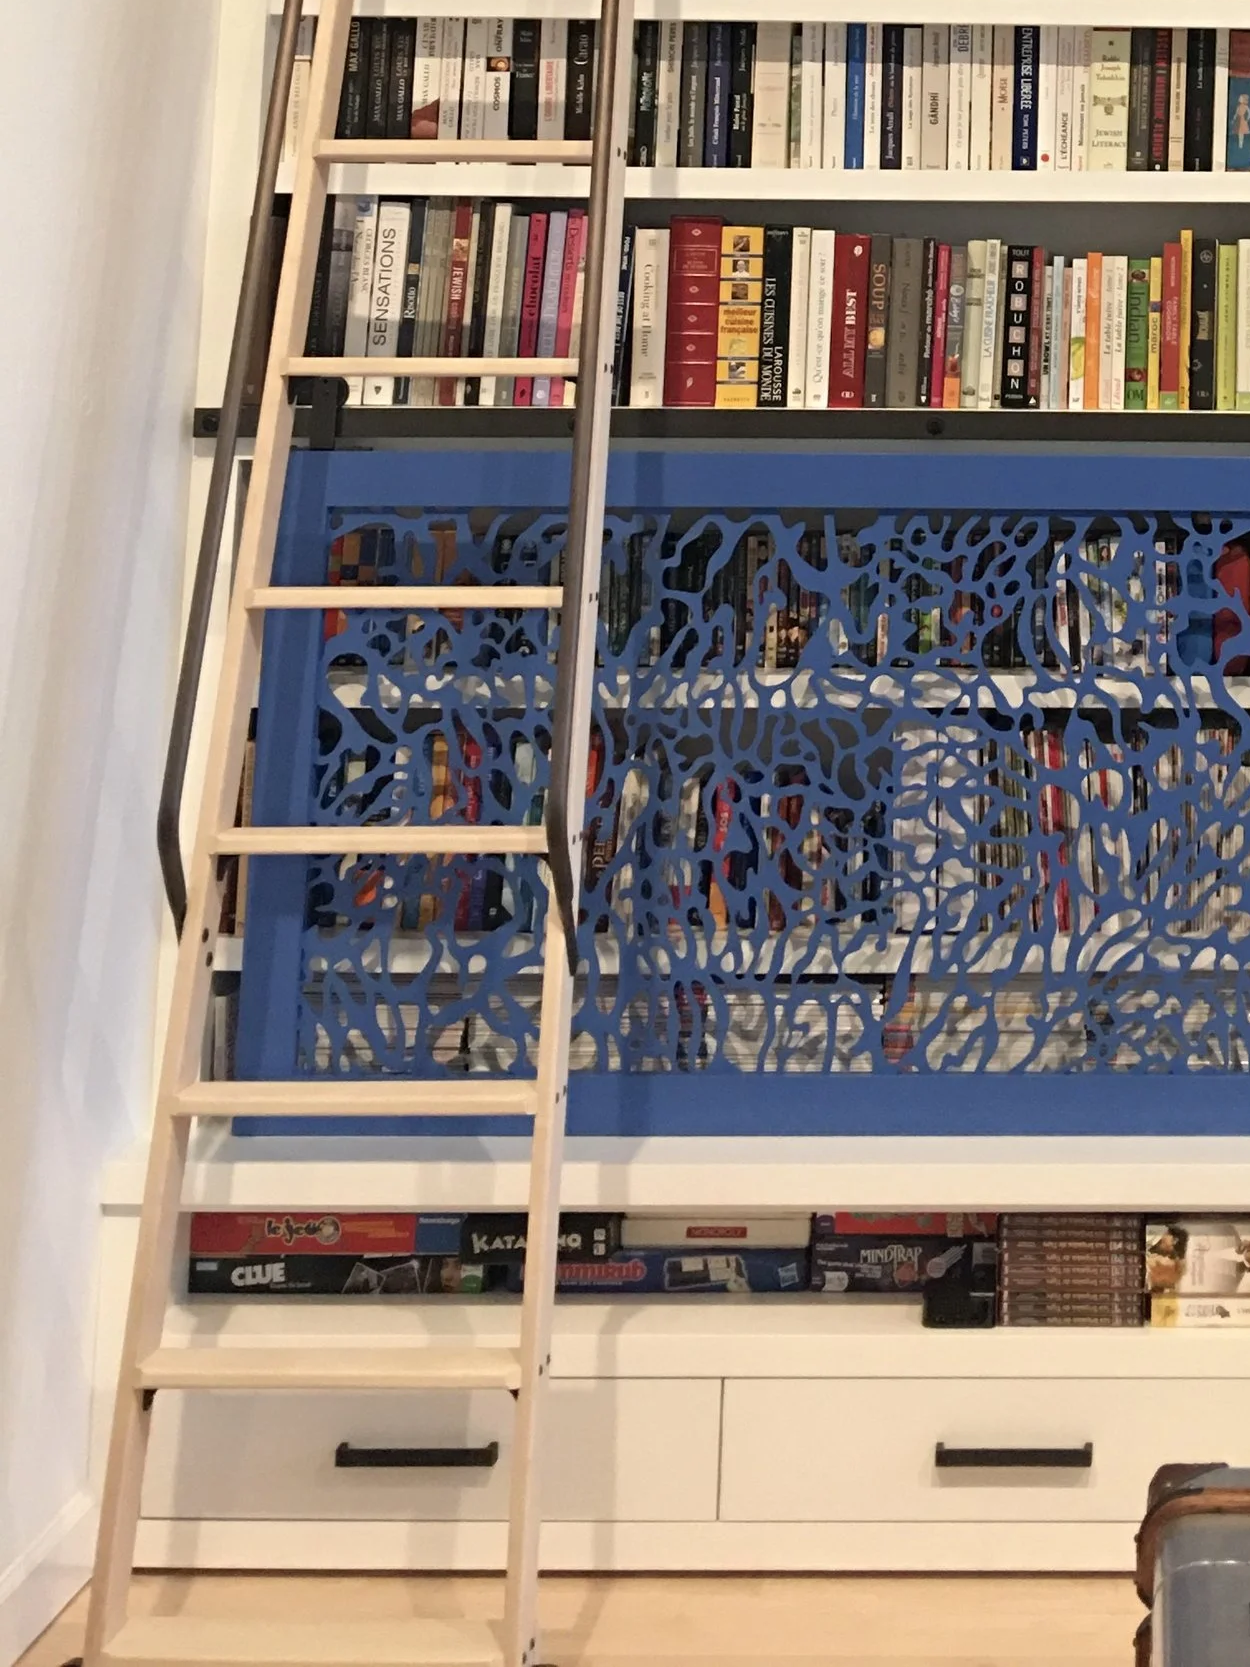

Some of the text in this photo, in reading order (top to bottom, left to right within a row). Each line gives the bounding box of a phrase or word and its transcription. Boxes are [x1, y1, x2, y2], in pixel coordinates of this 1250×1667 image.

[349, 21, 360, 72] MAX GALLO
[495, 19, 503, 52] ONFRAY
[668, 22, 677, 73] SHIMON PERES
[1020, 28, 1033, 77] ENTREPRISE
[493, 76, 501, 111] COSMOS
[544, 60, 554, 122] L'ORDRE LIBERTAIRE
[1020, 78, 1033, 110] LIBÉRÉE
[885, 133, 896, 159] Jacques
[1059, 112, 1069, 160] L'ÉCHÉANCE
[564, 227, 579, 271] Desserts
[371, 228, 397, 347] SENSATIONS
[403, 286, 416, 319] Risotto
[450, 267, 464, 302] JEWISH
[524, 256, 541, 317] chocolat
[871, 264, 887, 310] SOUP
[640, 263, 655, 357] Cooking at Home
[842, 289, 857, 378] ALL MY BEST
[984, 316, 994, 349] CUISINE
[1008, 261, 1030, 389] ROBUCHON
[1128, 290, 1147, 343] Indian
[761, 278, 777, 402] LES CUISINES DU MONDE
[1150, 317, 1159, 354] maroc
[772, 346, 783, 402] LAROUSSE
[471, 1232, 582, 1254] KATANO
[859, 1245, 923, 1267] MINDTRAP
[231, 1262, 286, 1287] CLUE
